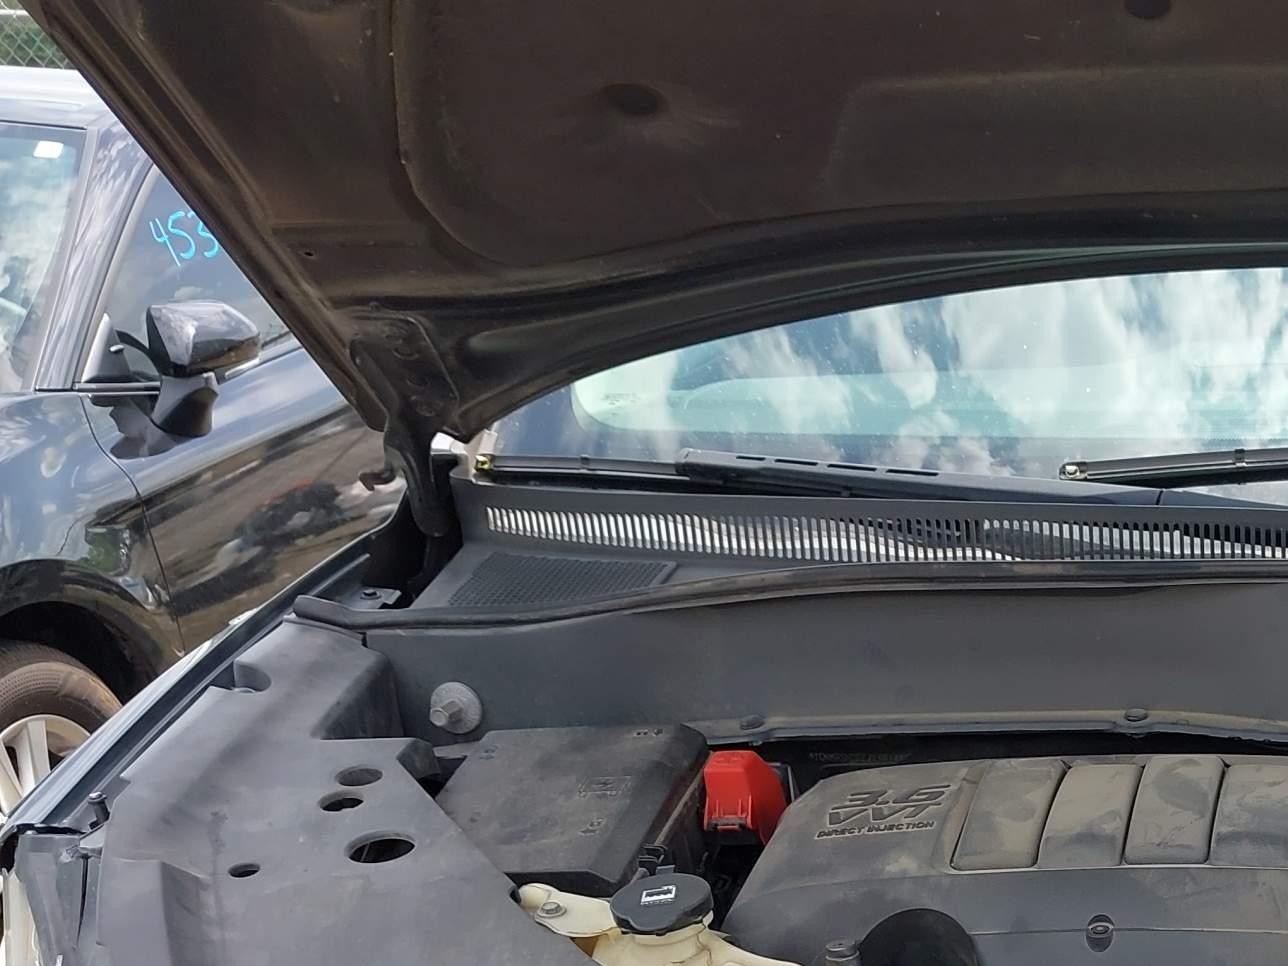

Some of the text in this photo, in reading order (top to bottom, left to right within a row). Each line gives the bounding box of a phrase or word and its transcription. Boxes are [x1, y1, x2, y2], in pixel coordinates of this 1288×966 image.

[831, 784, 951, 810] 3.6
[816, 821, 935, 839] DIRECT INJECTION
